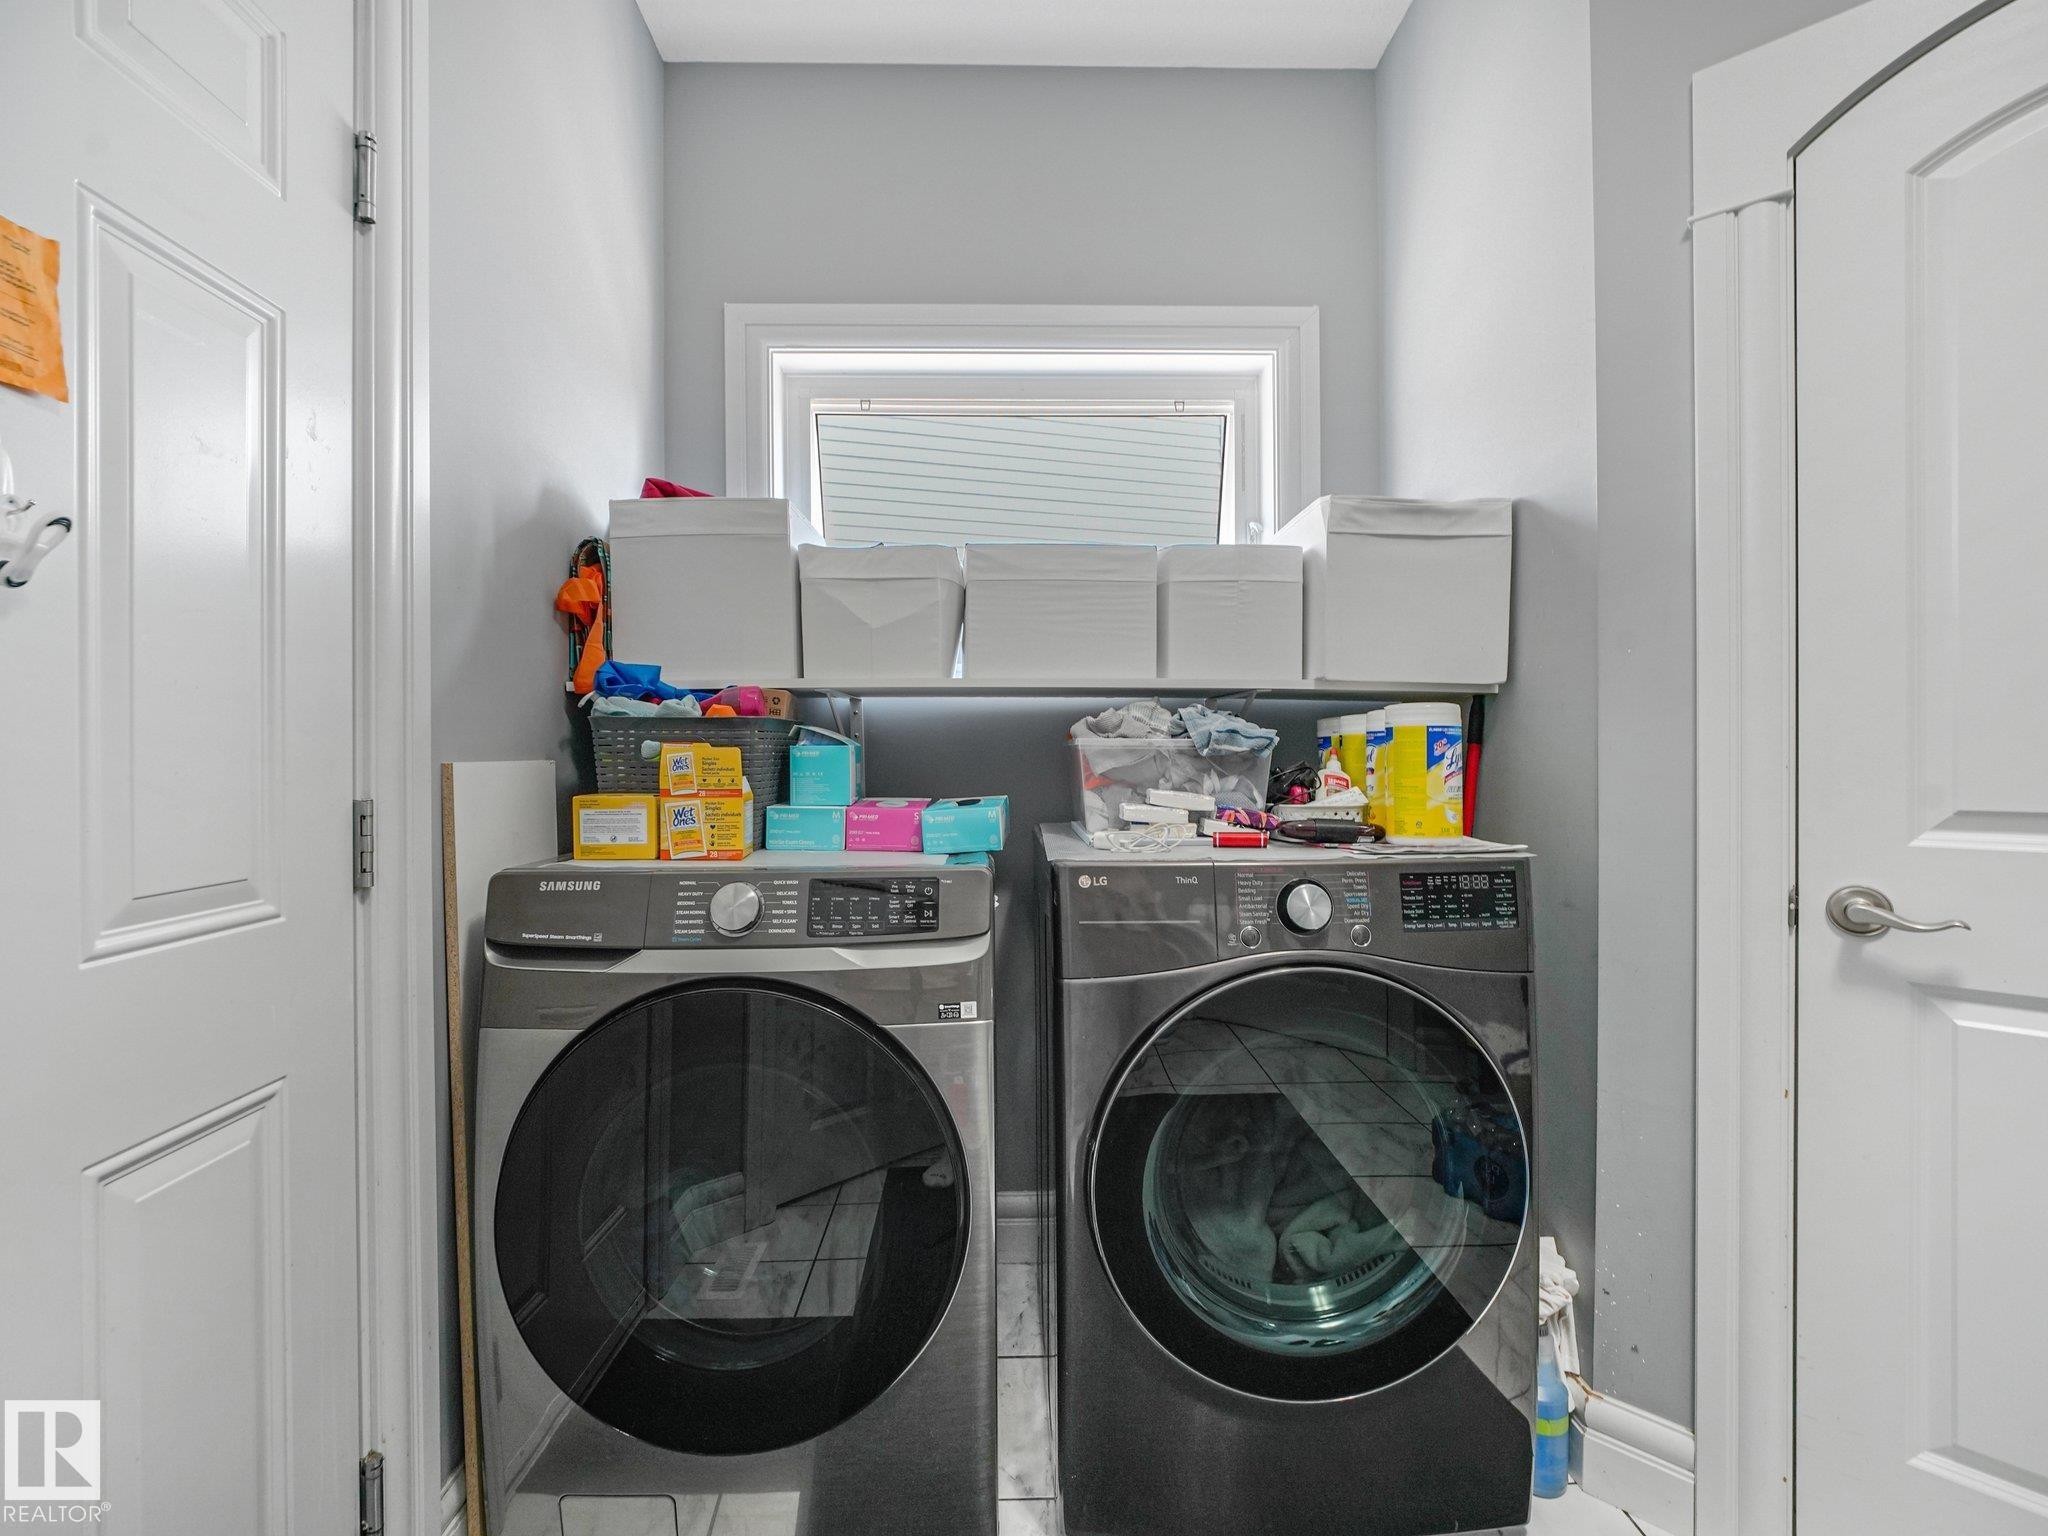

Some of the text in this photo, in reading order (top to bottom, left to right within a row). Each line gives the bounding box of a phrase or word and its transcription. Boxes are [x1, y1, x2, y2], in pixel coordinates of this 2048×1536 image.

[673, 756, 688, 766] Wet
[672, 764, 690, 772] Ones
[672, 806, 695, 818] Wet
[832, 811, 840, 819] M
[913, 811, 920, 820] S
[988, 810, 997, 819] M
[672, 816, 696, 827] Ones
[709, 850, 718, 858] 28
[1093, 876, 1107, 886] LG
[1175, 876, 1199, 884] ThinQ
[539, 880, 601, 891] SAMSUNG
